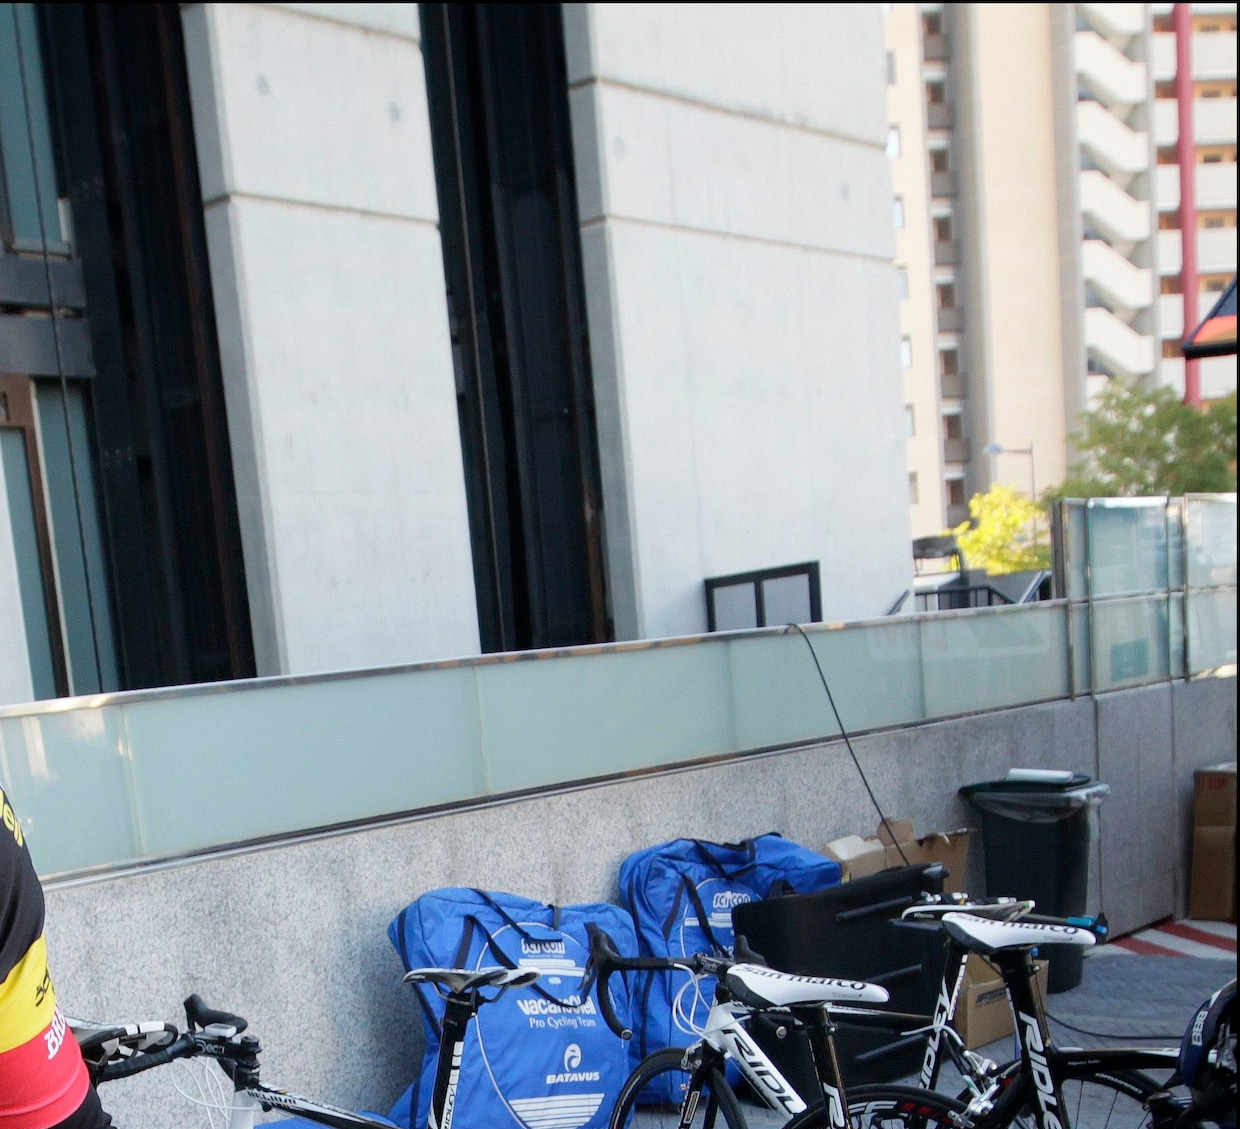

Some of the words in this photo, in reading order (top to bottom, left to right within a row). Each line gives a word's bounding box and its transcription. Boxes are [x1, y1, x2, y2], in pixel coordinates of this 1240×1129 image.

[529, 1017, 545, 1028] Pro
[547, 1016, 578, 1030] Cycling
[578, 1014, 597, 1028] Team
[546, 1071, 600, 1085] BATAVUS
